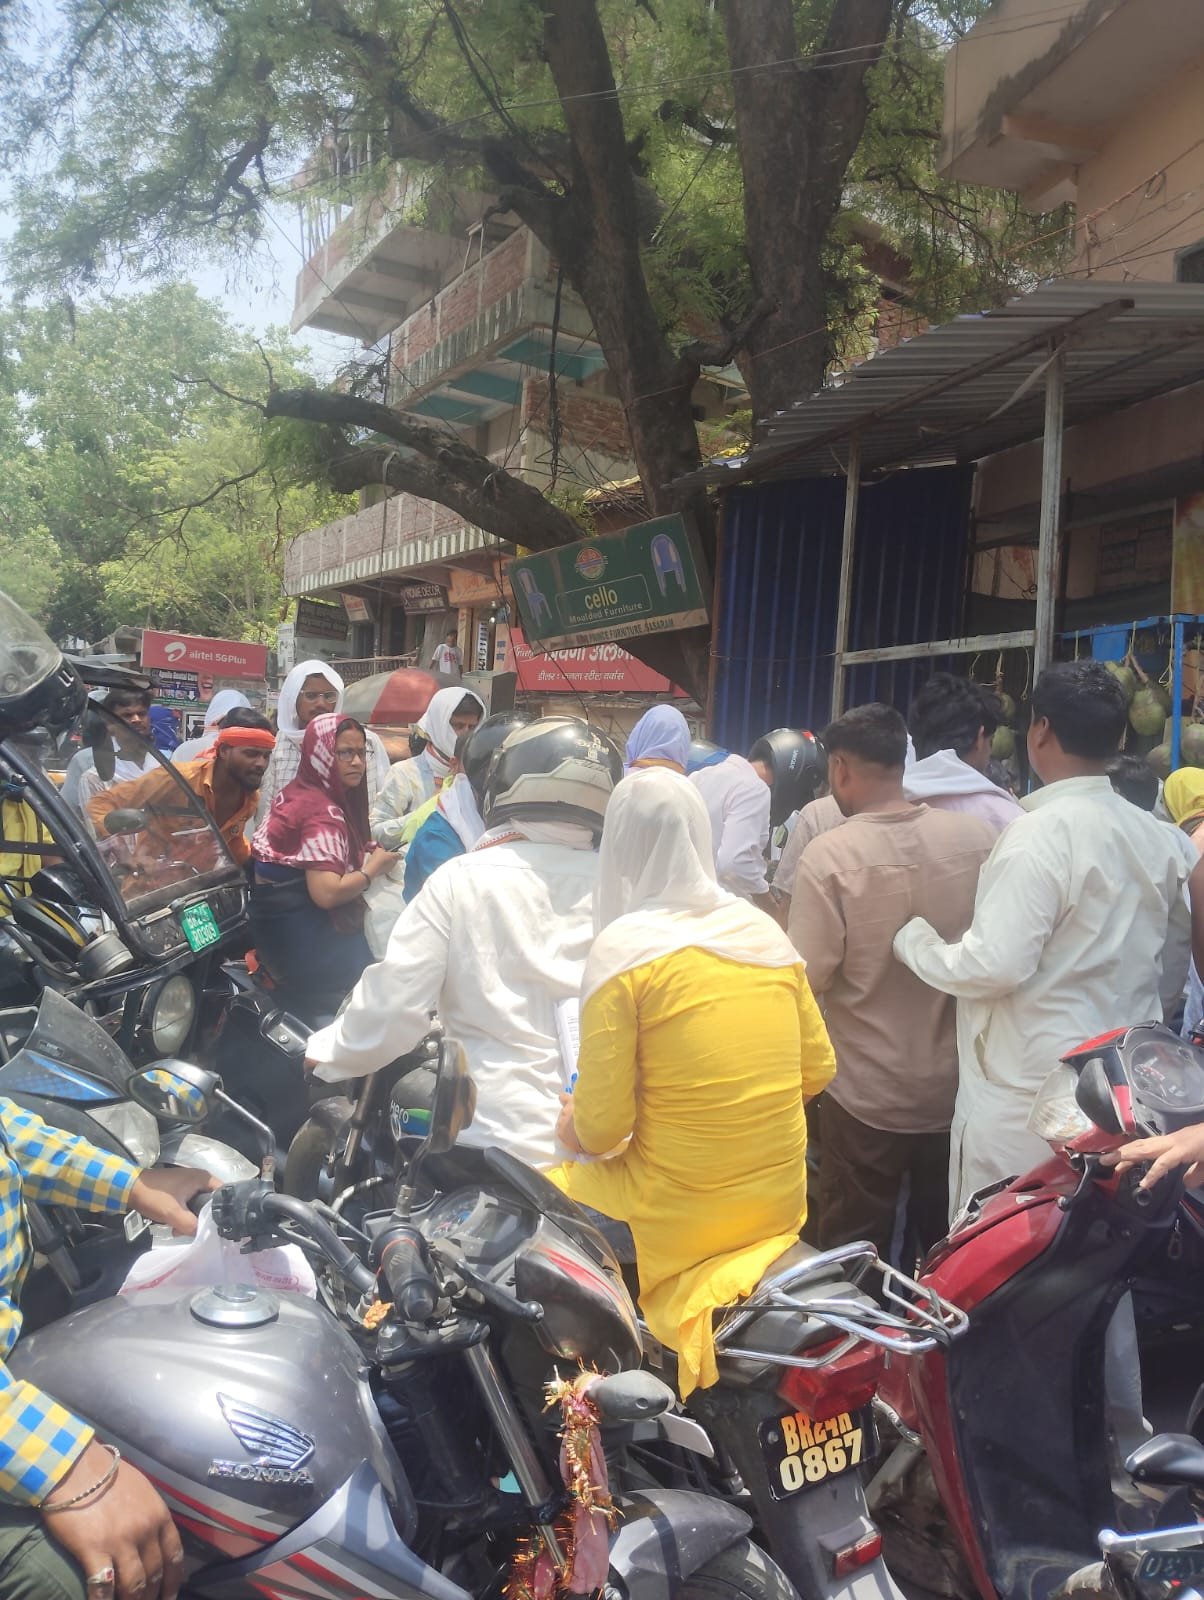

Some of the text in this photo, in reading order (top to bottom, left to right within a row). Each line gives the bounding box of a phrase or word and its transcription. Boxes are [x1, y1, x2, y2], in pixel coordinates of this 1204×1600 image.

[422, 584, 441, 597] DECOR
[584, 586, 618, 610] cello
[568, 601, 643, 624] Moulded Furniture
[609, 624, 642, 640] FURNITURE
[189, 650, 213, 661] airtel
[389, 1099, 409, 1124] Hero
[207, 1458, 314, 1484] HONDA
[779, 1427, 862, 1492] 0867
